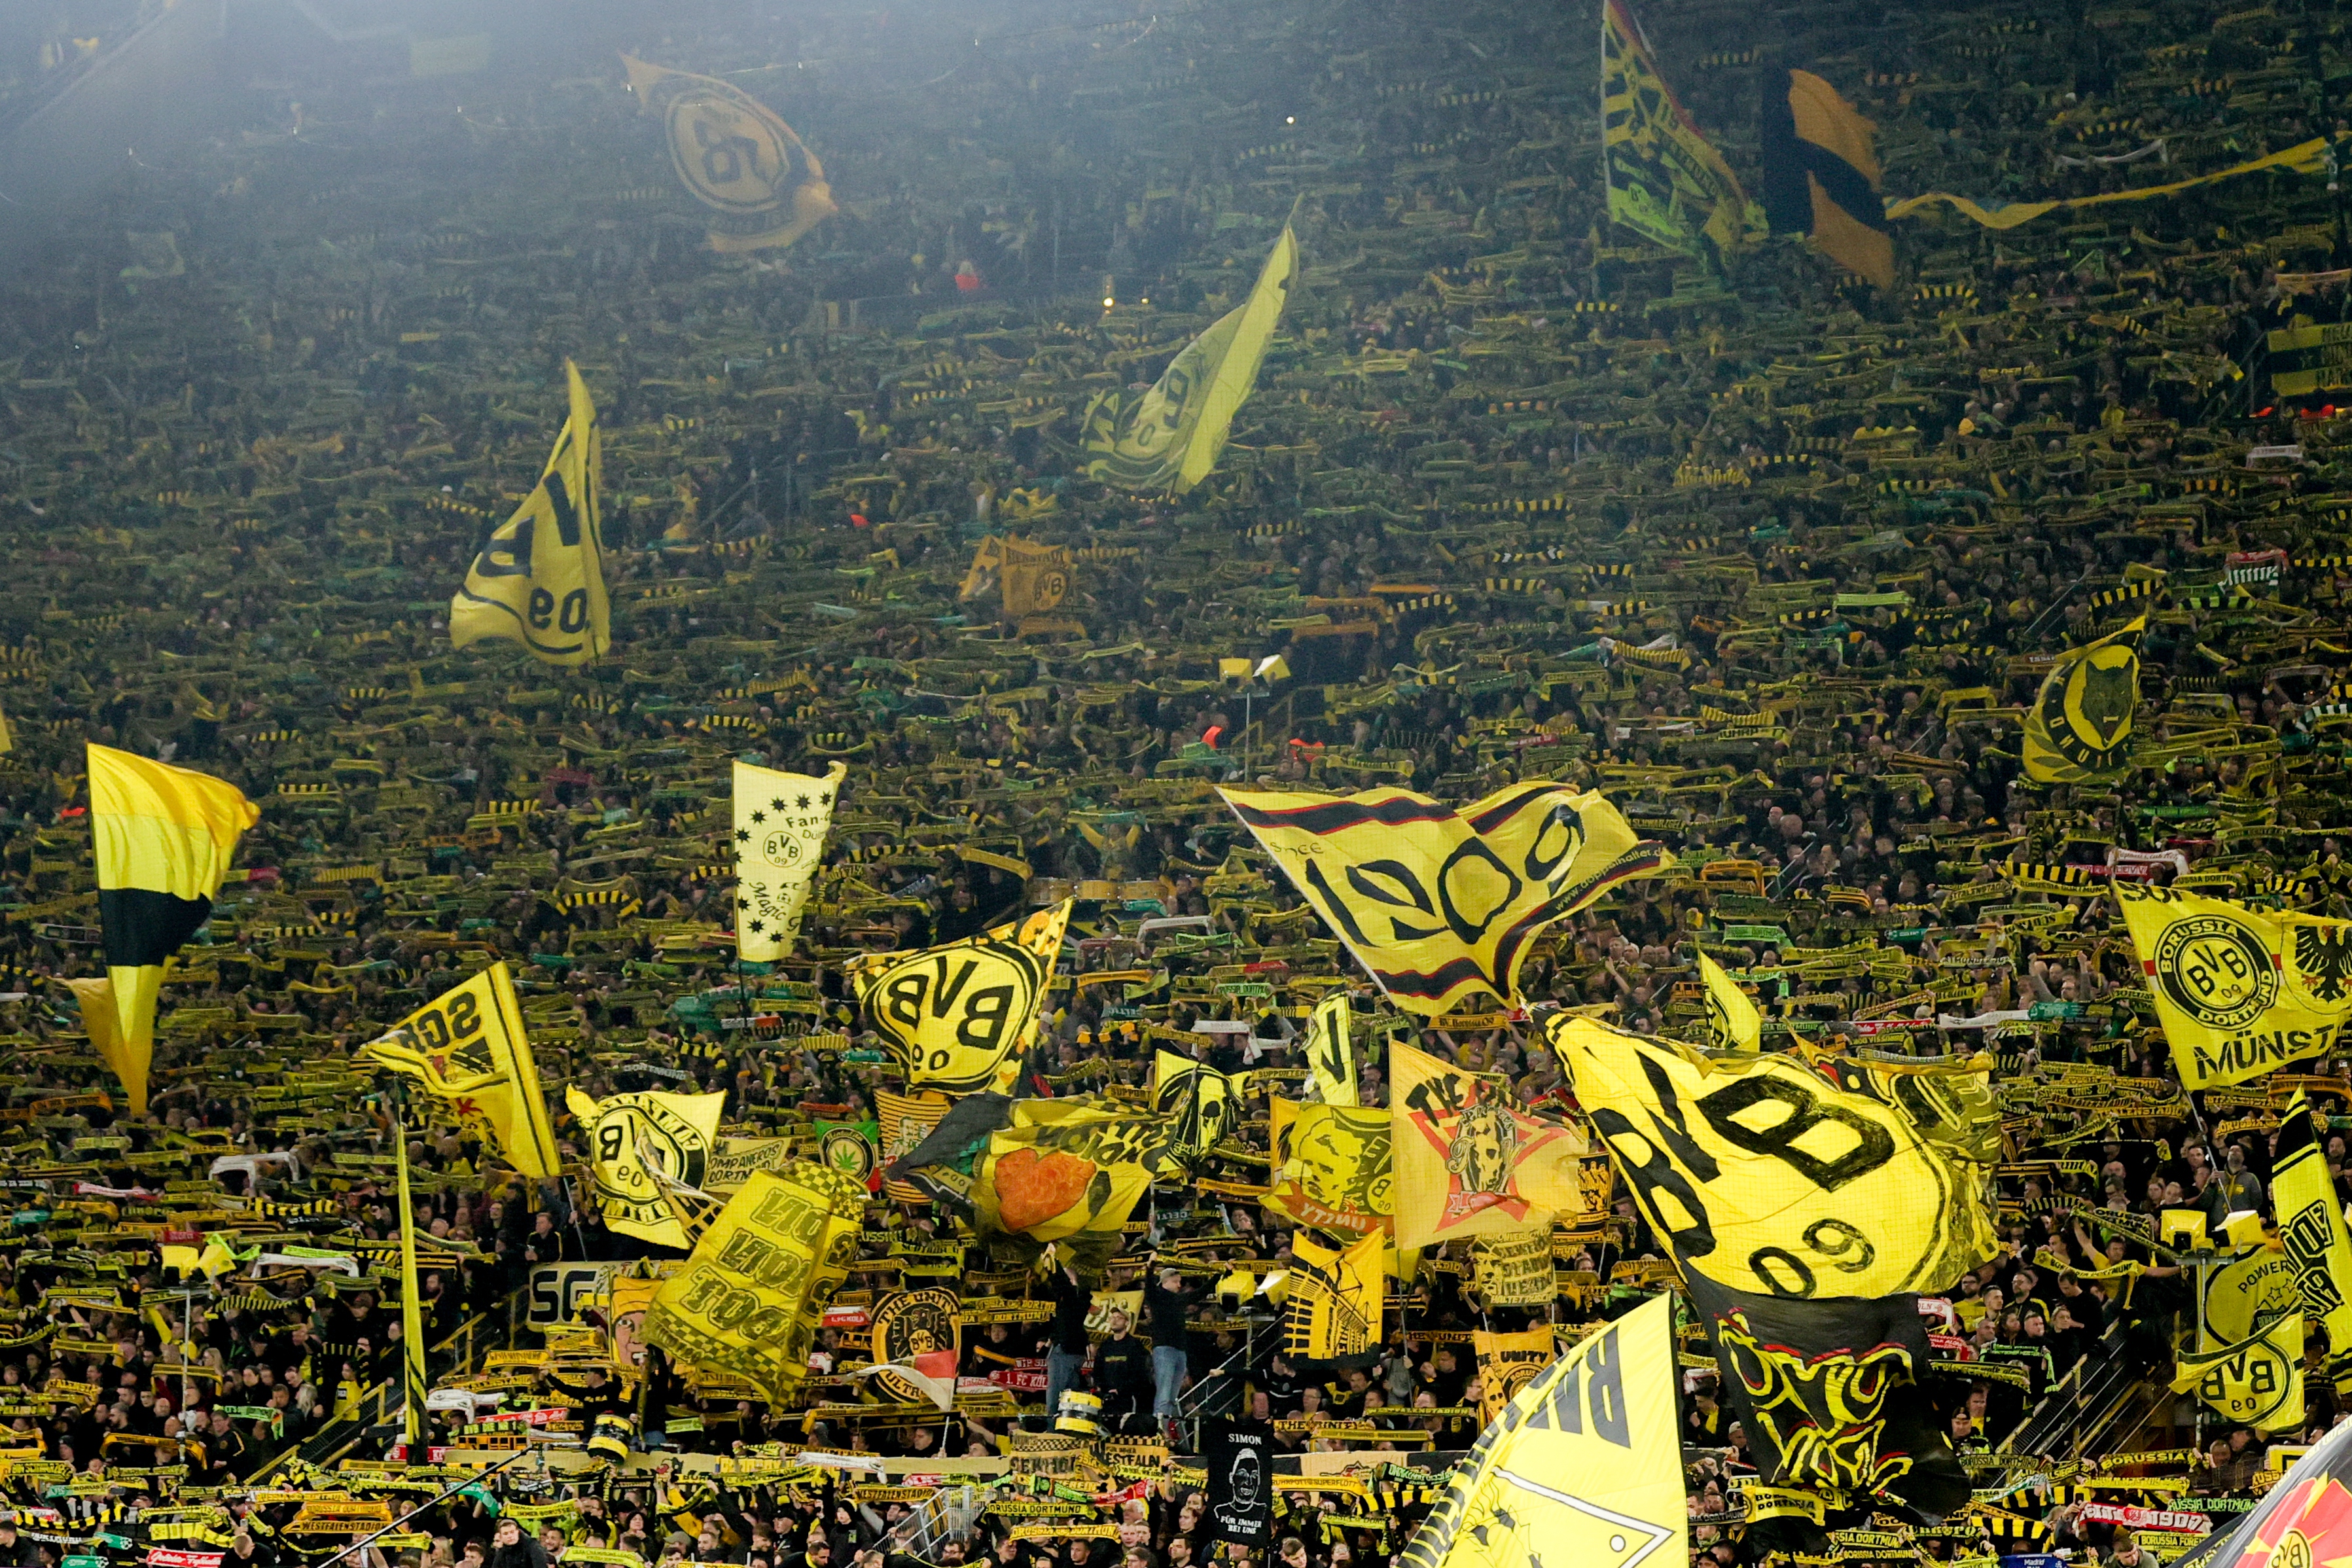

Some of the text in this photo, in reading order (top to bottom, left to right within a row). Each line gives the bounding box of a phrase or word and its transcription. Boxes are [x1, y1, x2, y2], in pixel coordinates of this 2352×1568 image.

[767, 835, 799, 859] BVB
[774, 855, 788, 865] 09
[1306, 804, 1584, 947] 1909
[1556, 847, 1664, 912] www.doppelhalter.d
[749, 882, 787, 921] Magic
[2160, 921, 2239, 973] BORUSSIA
[2186, 944, 2247, 997] BVB
[2198, 970, 2273, 1030] DORTMUND
[2220, 983, 2242, 999] 09
[1406, 1072, 1466, 1127] THE
[1590, 1050, 1895, 1256] BVB
[1748, 1218, 1874, 1299] 09
[877, 1290, 957, 1326] THE UNITY
[910, 1332, 933, 1352] BVB
[1501, 1351, 1548, 1363] UNITY
[885, 1370, 925, 1400] ULTRA
[1006, 1375, 1013, 1384] 1.
[1016, 1375, 1027, 1385] FC
[1279, 1420, 1307, 1431] THE
[1228, 1433, 1262, 1445] SIMON
[2101, 1452, 2185, 1470] BORUSSIA
[984, 1503, 1081, 1514] BORUSSIA DORTMUND
[2207, 1499, 2254, 1511] DORTMUN
[1221, 1515, 1262, 1528] FÜR IMMER
[1705, 1512, 1745, 1522] DORTMUN
[2146, 1512, 2203, 1531] 1907
[1012, 1526, 1054, 1537] ORUSSIA
[1242, 1526, 1256, 1535] UNS
[2141, 1535, 2178, 1545] BORUSSIA
